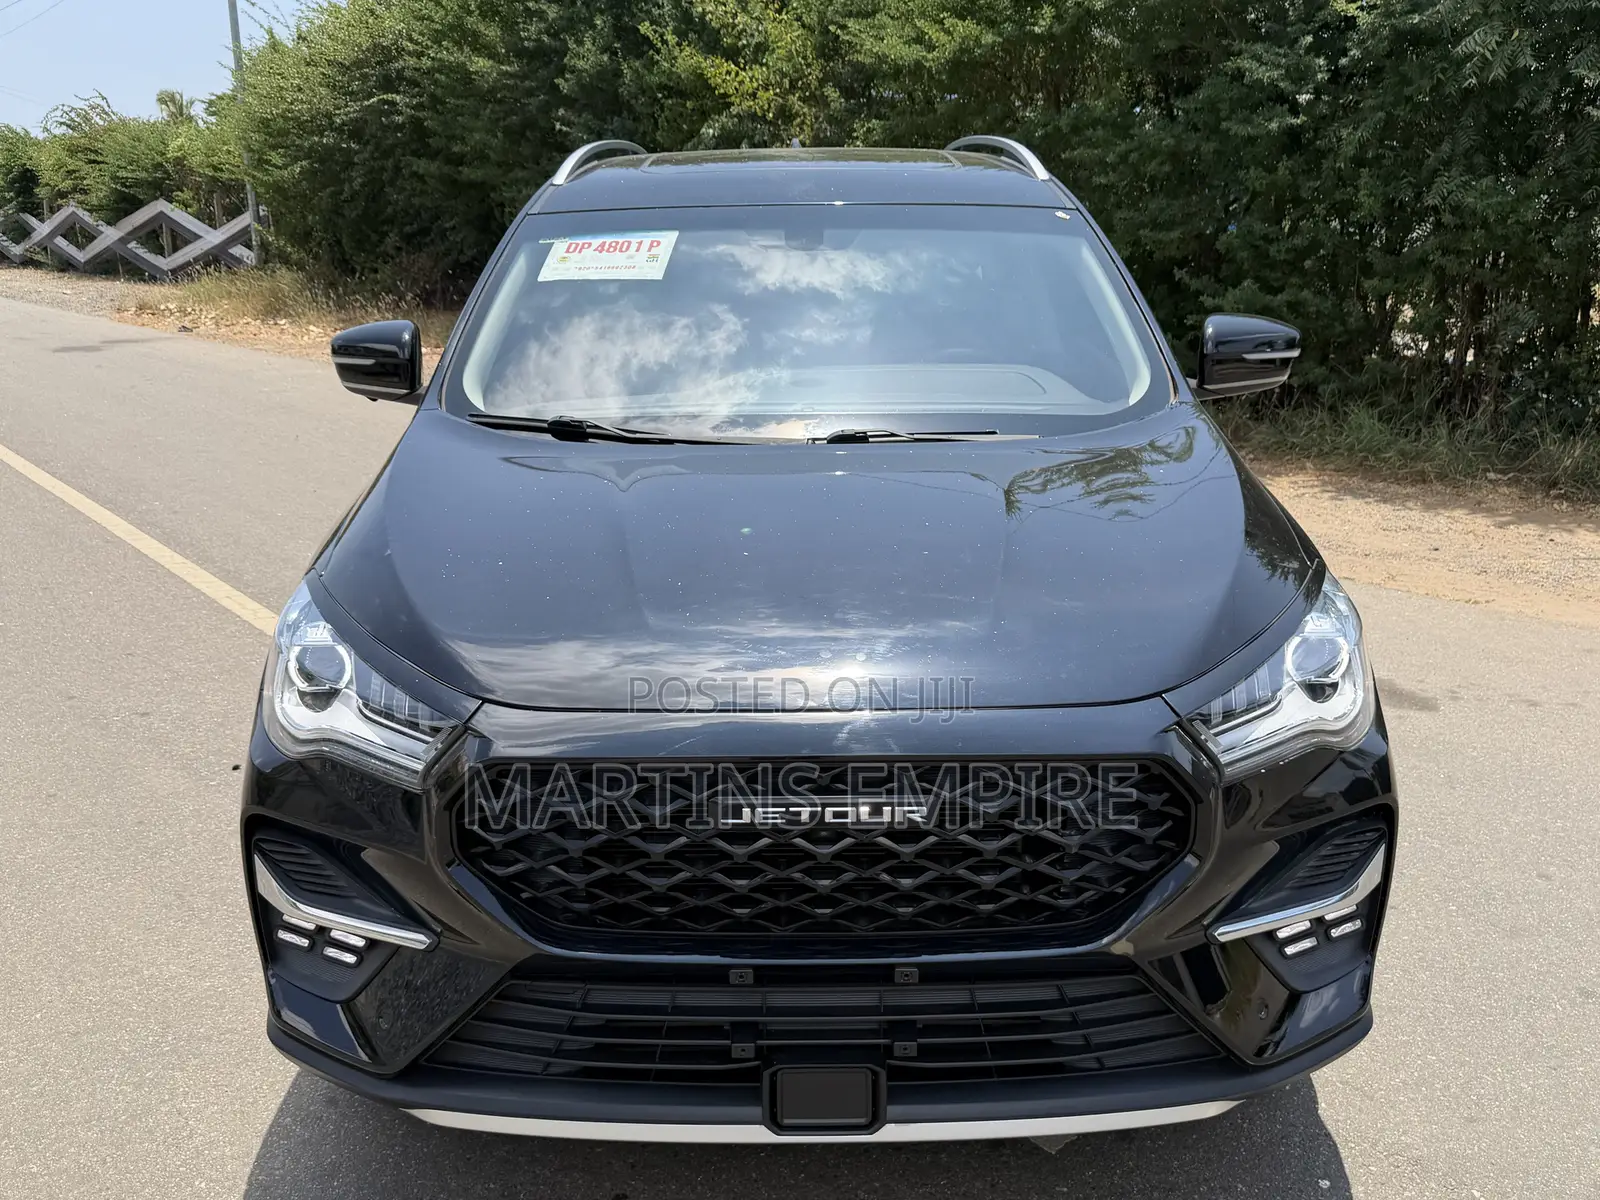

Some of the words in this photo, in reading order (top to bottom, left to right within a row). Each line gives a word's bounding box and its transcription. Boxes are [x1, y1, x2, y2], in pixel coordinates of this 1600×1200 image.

[564, 241, 592, 254] DP
[593, 239, 643, 254] 4801
[647, 240, 661, 253] P
[720, 807, 928, 824] JETOUR
